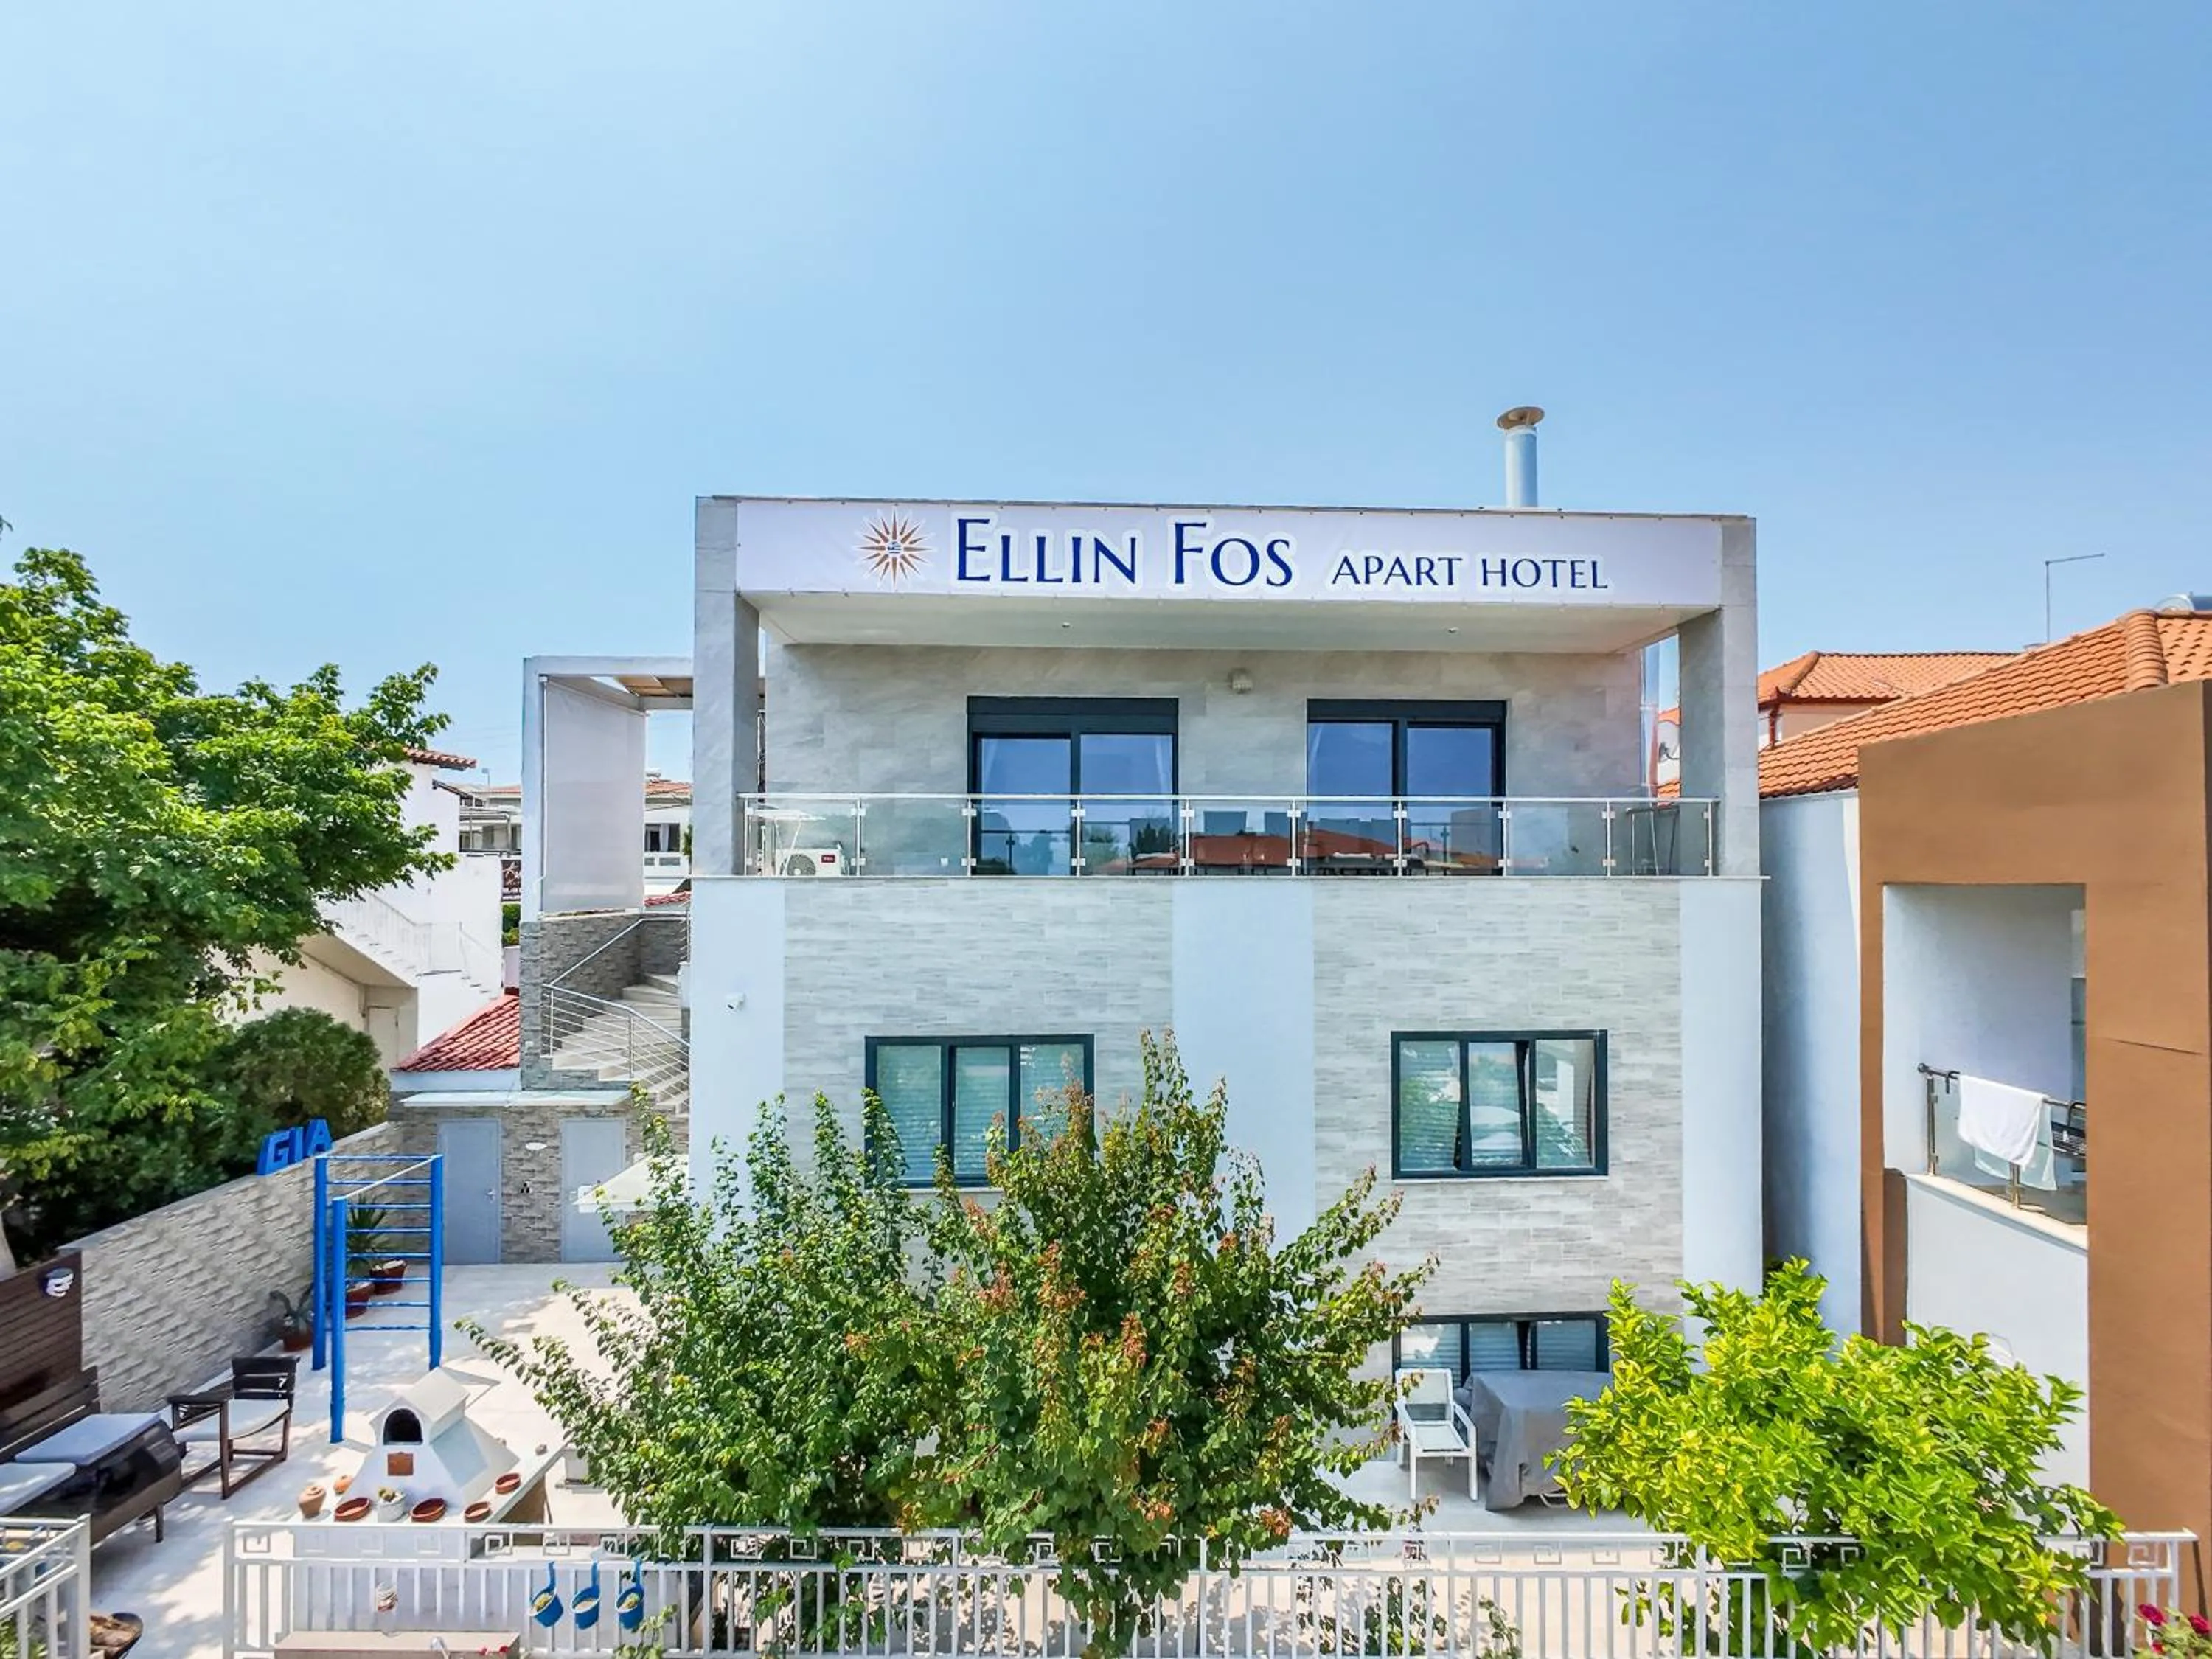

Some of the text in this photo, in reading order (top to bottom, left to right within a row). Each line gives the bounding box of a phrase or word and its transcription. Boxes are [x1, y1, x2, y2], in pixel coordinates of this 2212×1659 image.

[957, 518, 1608, 589] ELLIN FOS APART HOTEL
